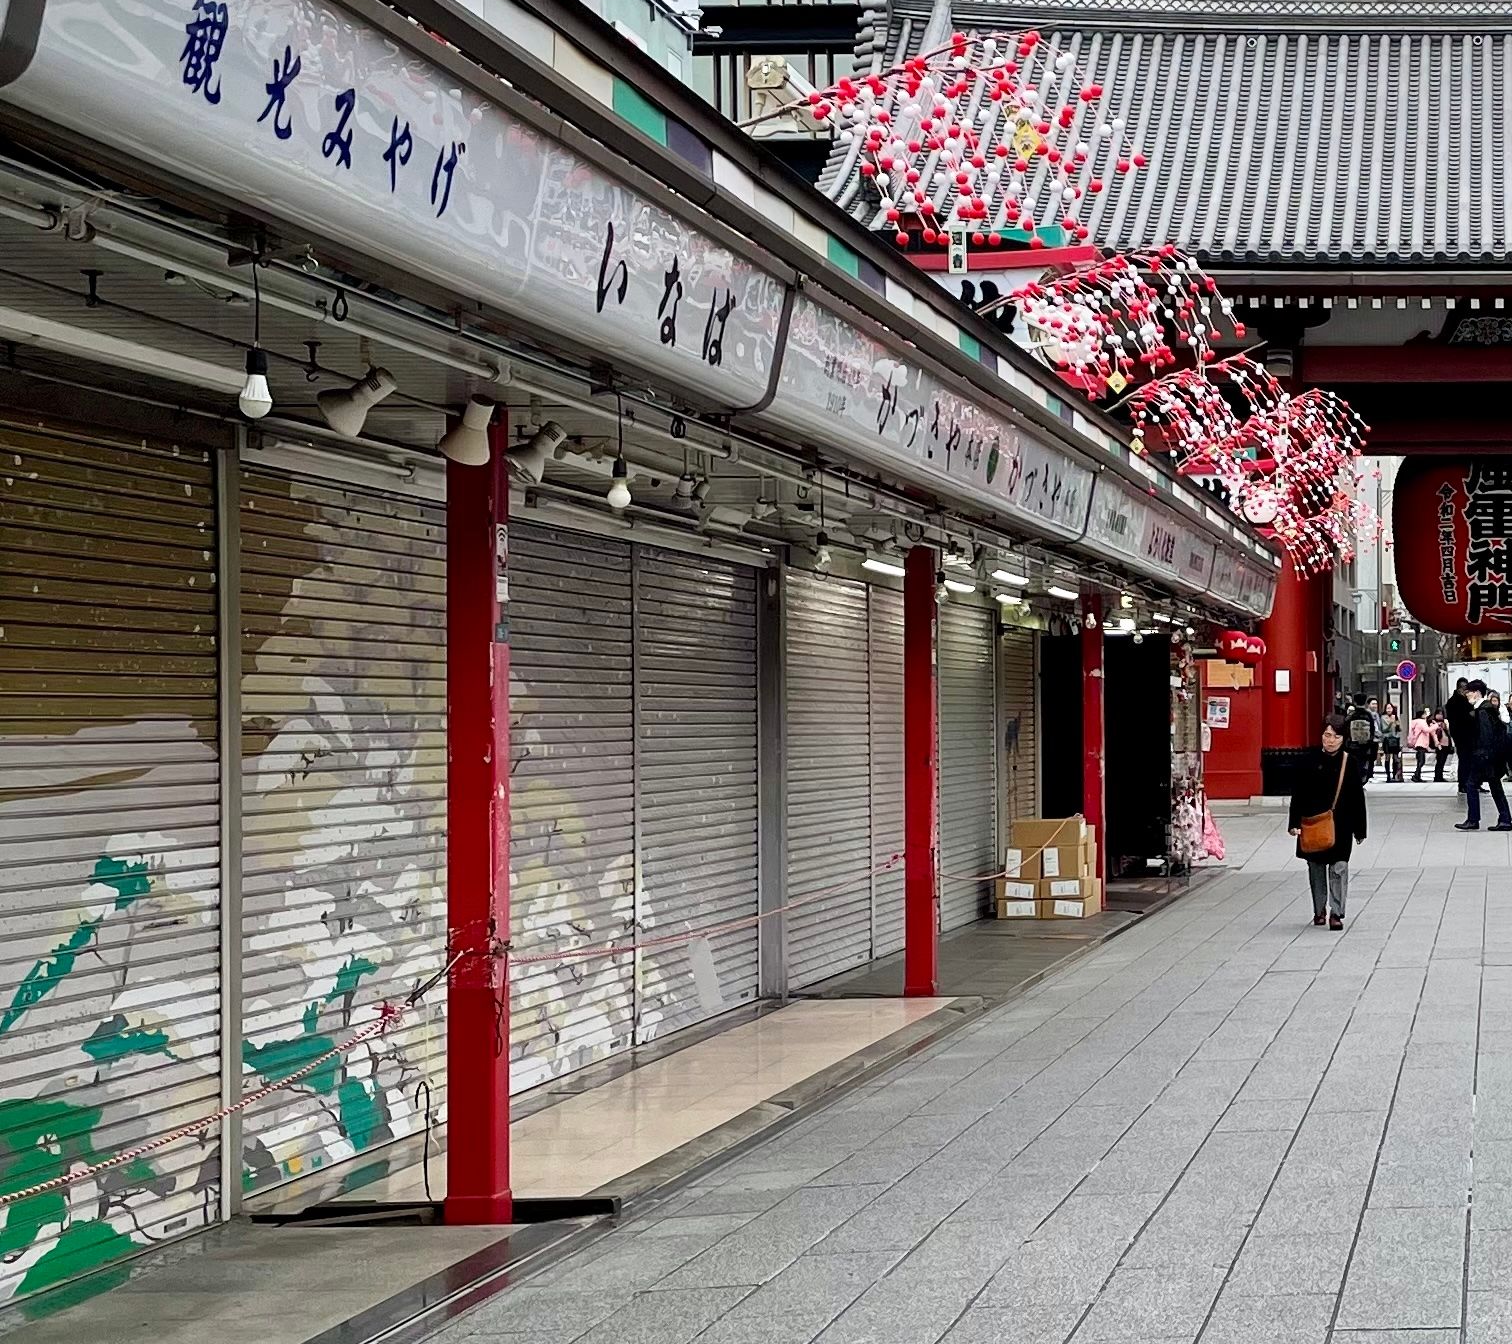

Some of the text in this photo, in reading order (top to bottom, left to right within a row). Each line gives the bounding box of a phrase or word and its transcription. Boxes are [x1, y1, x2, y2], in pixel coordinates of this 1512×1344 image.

[597, 223, 736, 365] いなば
[1436, 481, 1458, 604] 令和二年四月吉日
